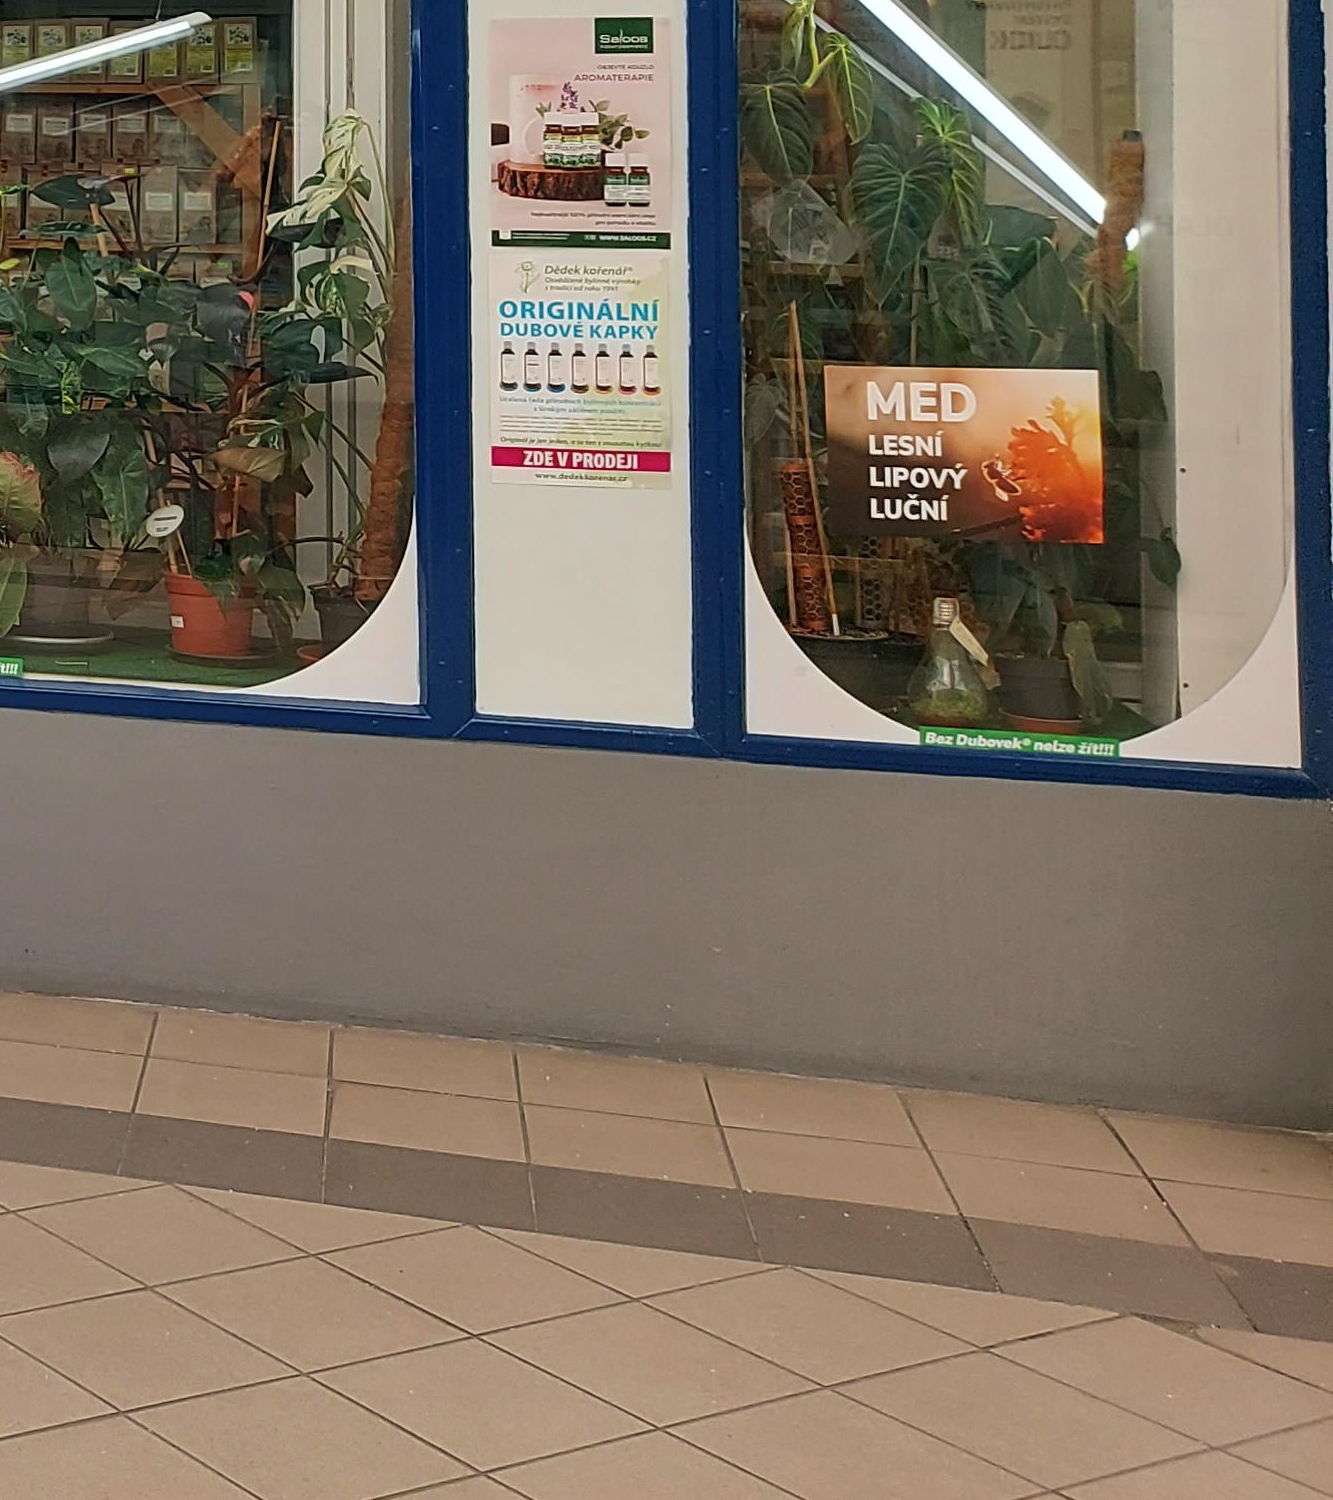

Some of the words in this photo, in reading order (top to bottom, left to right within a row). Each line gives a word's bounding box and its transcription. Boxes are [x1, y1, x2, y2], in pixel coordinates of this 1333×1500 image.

[574, 73, 654, 82] AROMATERAPIE
[545, 265, 581, 275] Dědek
[499, 298, 660, 322] ORIGINÁLNÍ
[500, 321, 584, 338] DUBOVÉ
[590, 325, 658, 340] KAPKY
[867, 381, 977, 422] MED
[868, 431, 943, 456] LESNÍ
[523, 451, 553, 466] ZDE
[557, 452, 570, 467] V
[572, 452, 638, 470] PRODEJI
[869, 463, 968, 490] LIPOVÝ
[870, 494, 949, 521] LUČNÍ
[925, 731, 954, 746] Bez
[1033, 741, 1076, 754] nelze
[1077, 741, 1116, 757] žít!!!
